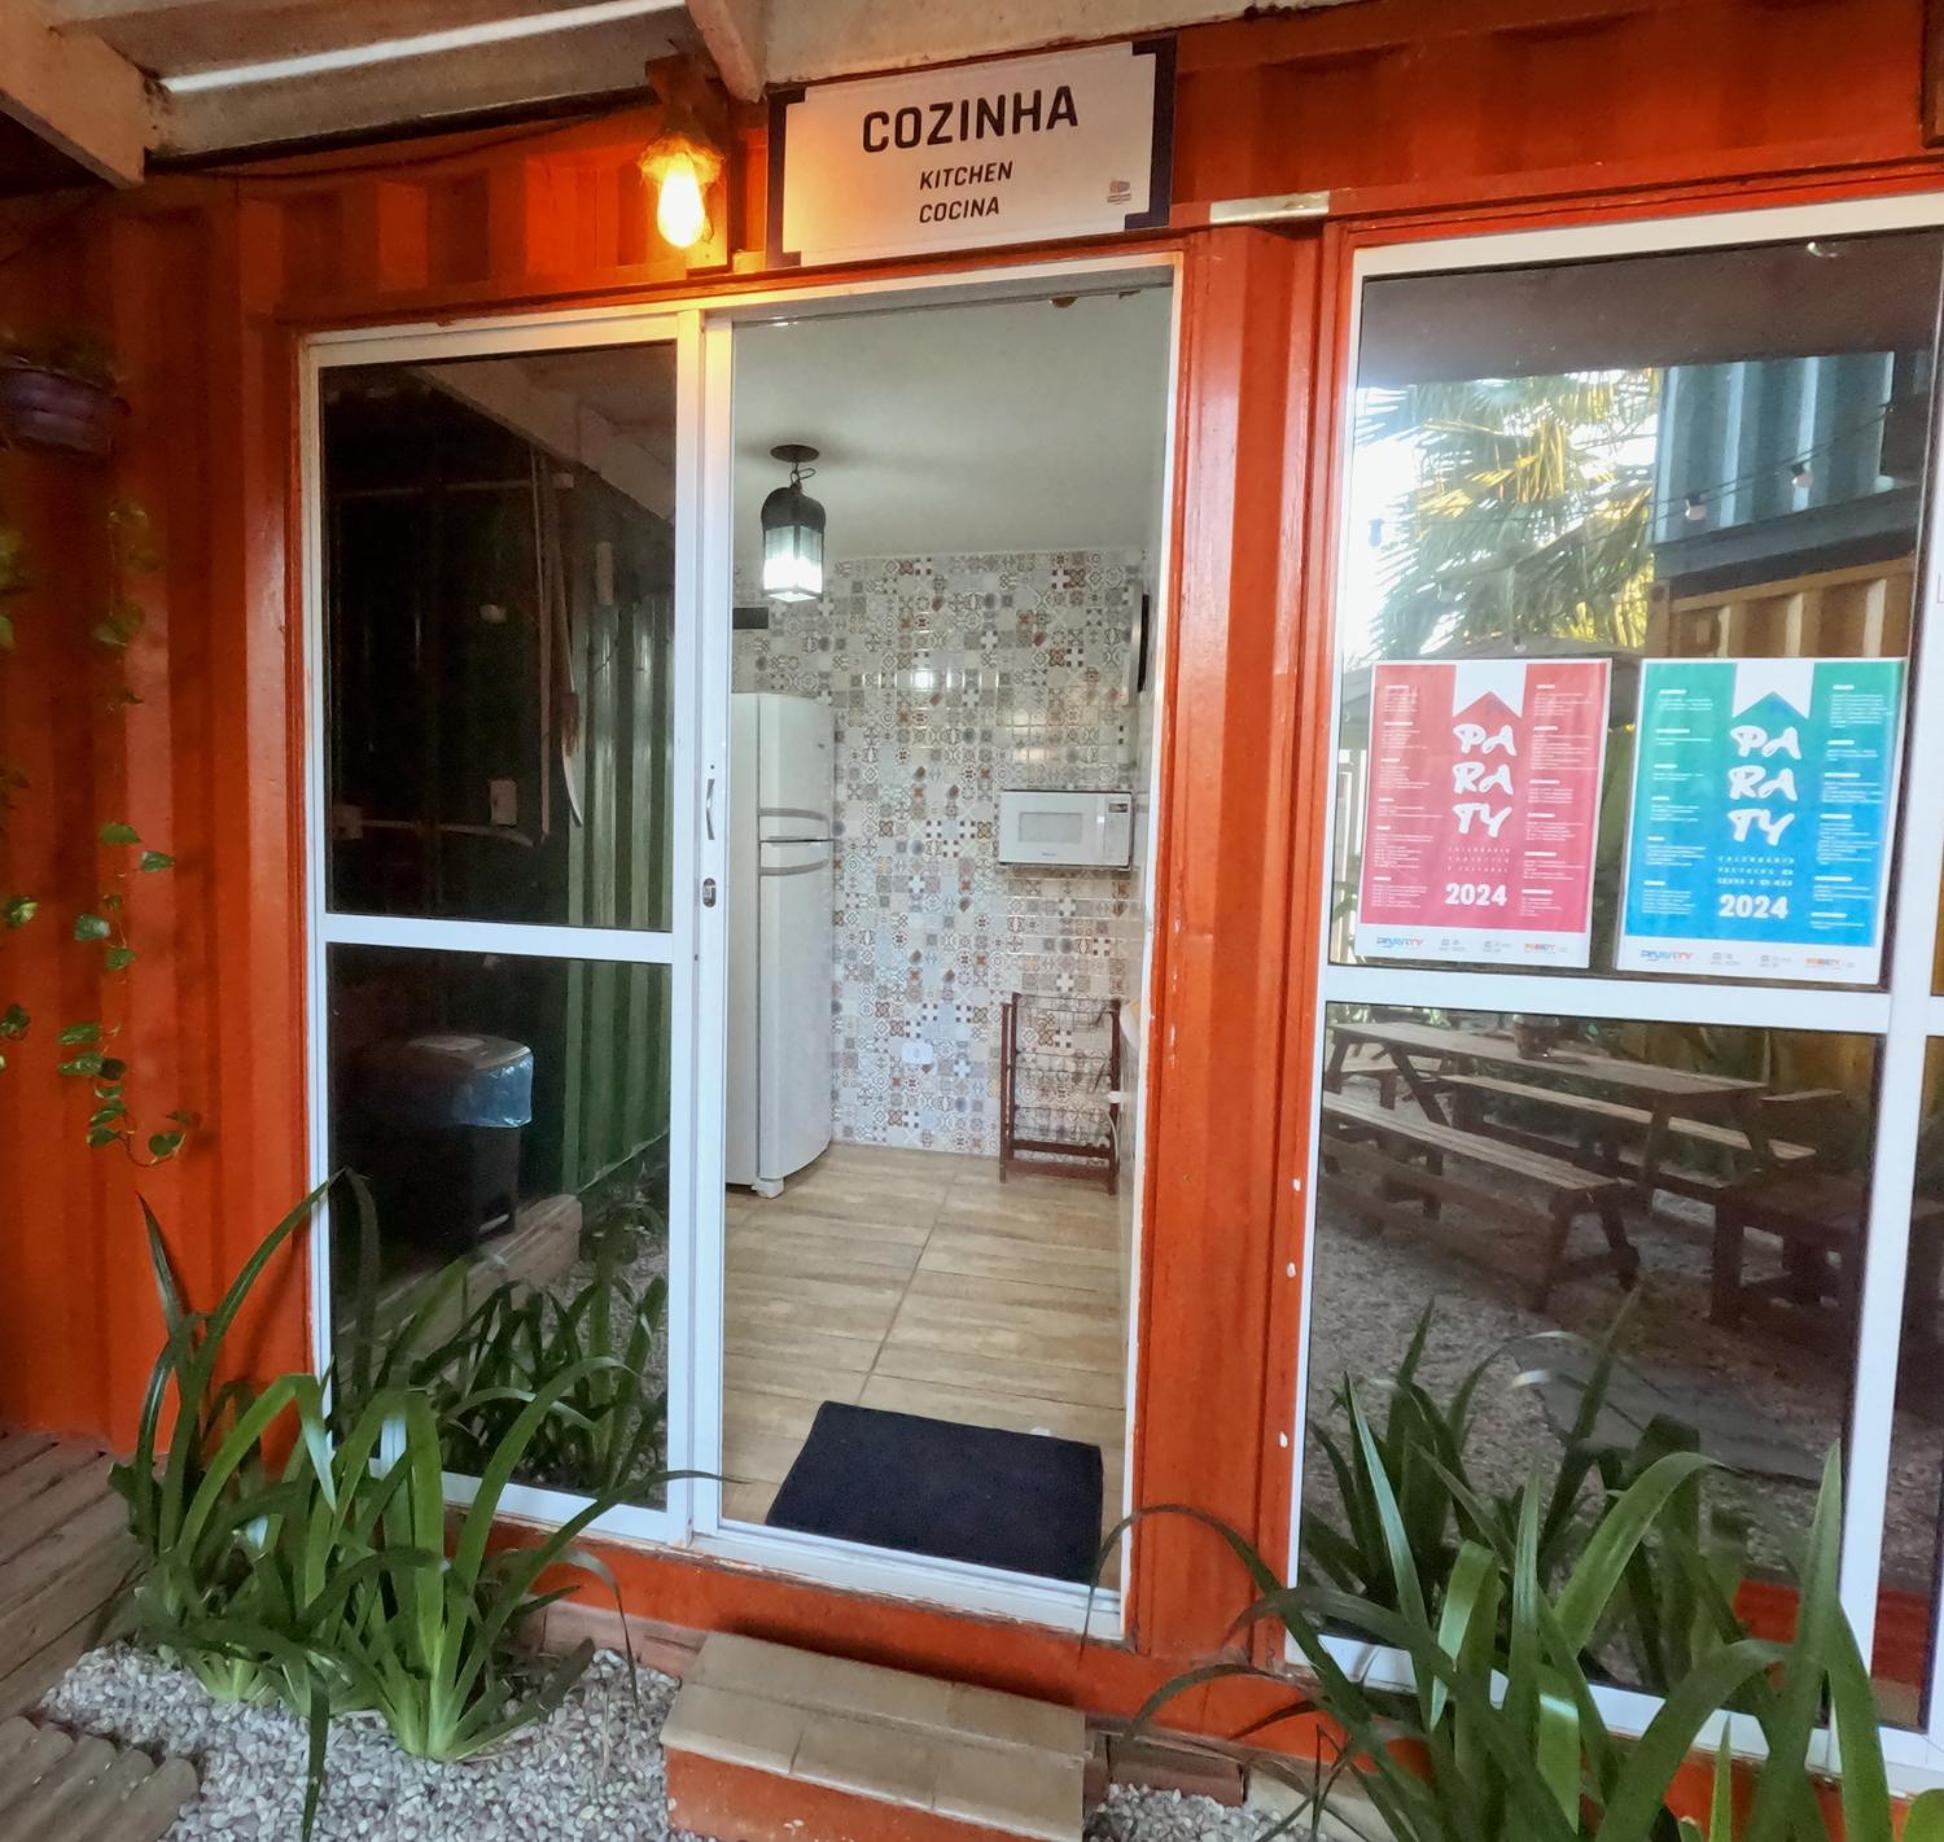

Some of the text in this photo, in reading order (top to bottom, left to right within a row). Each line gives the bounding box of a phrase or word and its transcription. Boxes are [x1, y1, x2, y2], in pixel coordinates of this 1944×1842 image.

[862, 85, 1079, 153] COZINHA
[919, 160, 1013, 190] KITCHEN
[918, 196, 1000, 224] COCINA
[1453, 723, 1516, 756] PA
[1730, 725, 1801, 759] PA
[1452, 762, 1513, 795] RA
[1728, 765, 1798, 801] RA
[1452, 802, 1512, 837] TY
[1727, 808, 1794, 845] TY
[1445, 882, 1507, 907] 2024
[1718, 893, 1788, 919] 2024
